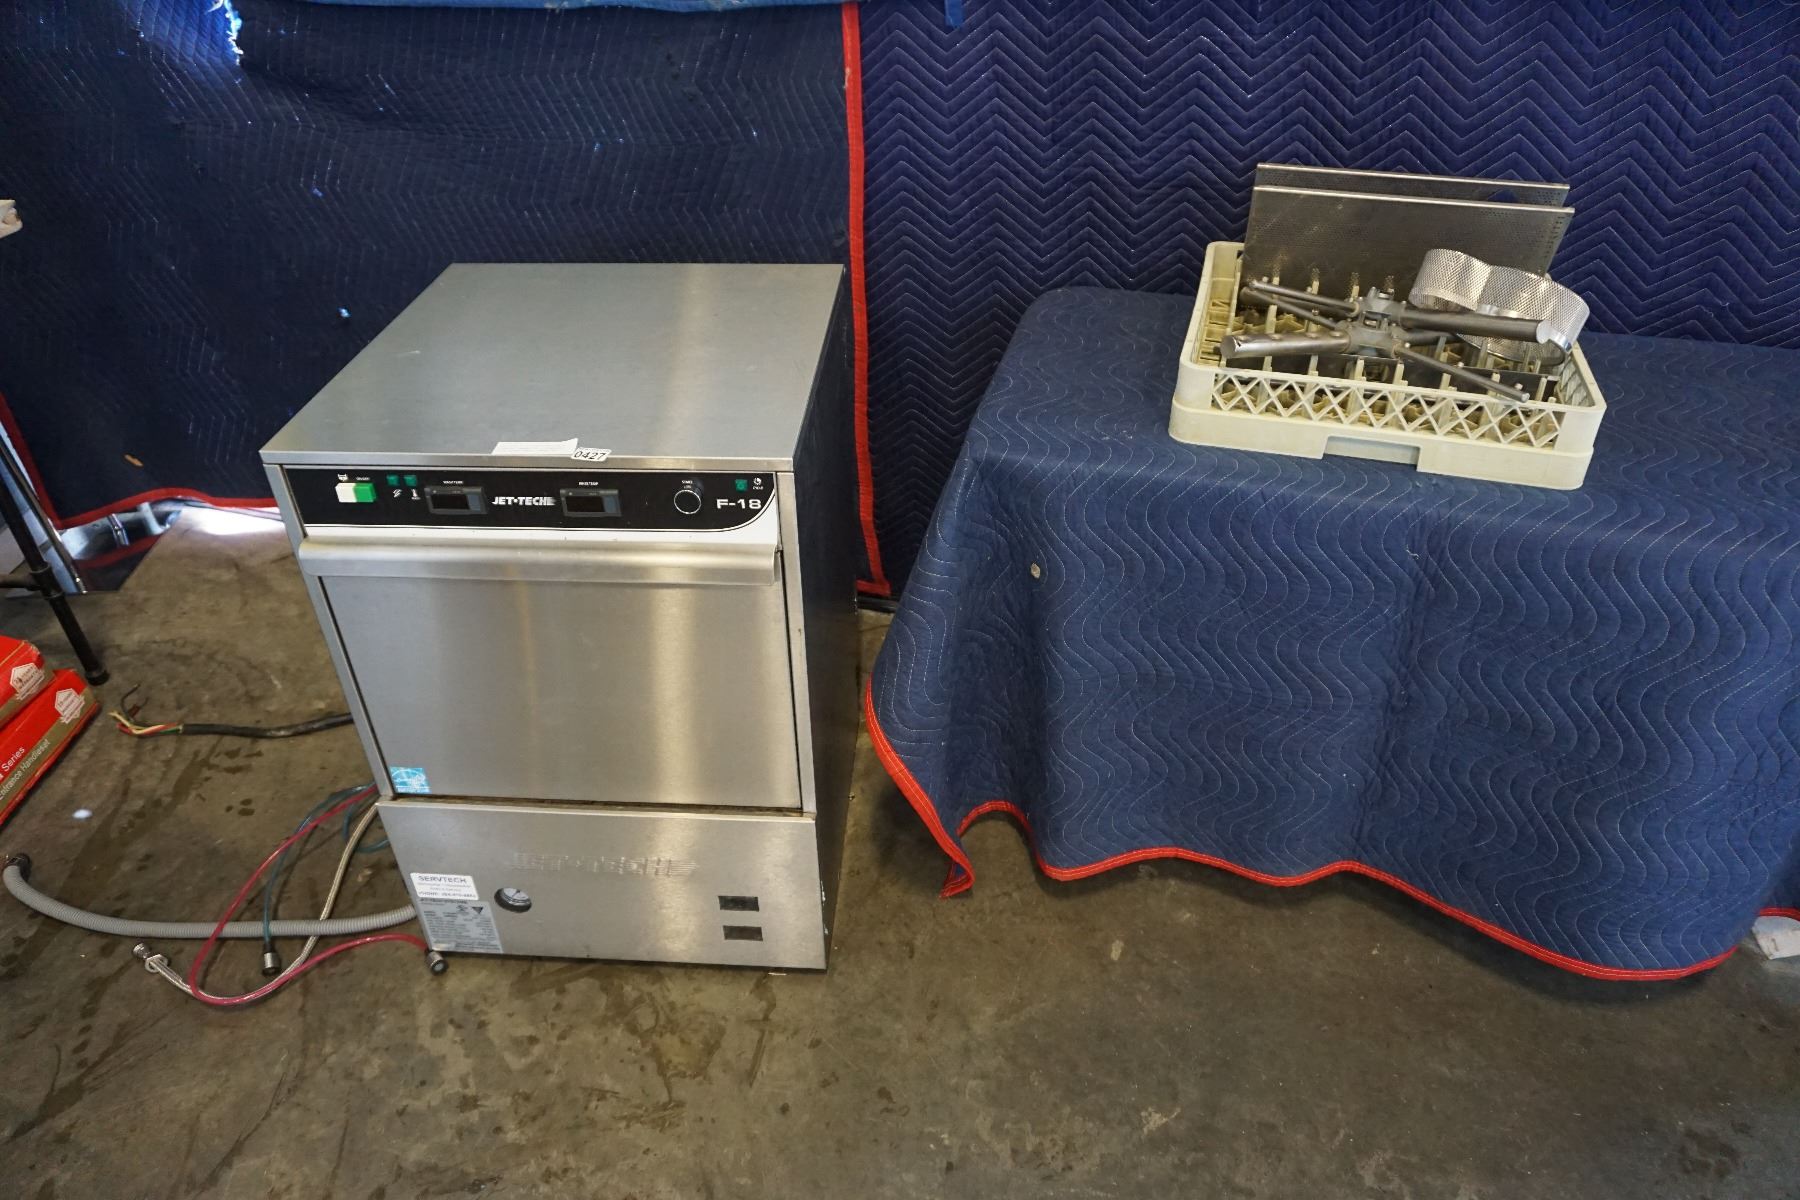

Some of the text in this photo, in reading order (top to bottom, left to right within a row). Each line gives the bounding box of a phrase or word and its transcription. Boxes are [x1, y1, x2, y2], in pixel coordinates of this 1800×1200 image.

[574, 451, 605, 460] 0427
[716, 499, 762, 509] F-18
[2, 747, 25, 772] Series
[418, 875, 467, 884] SERVTECH
